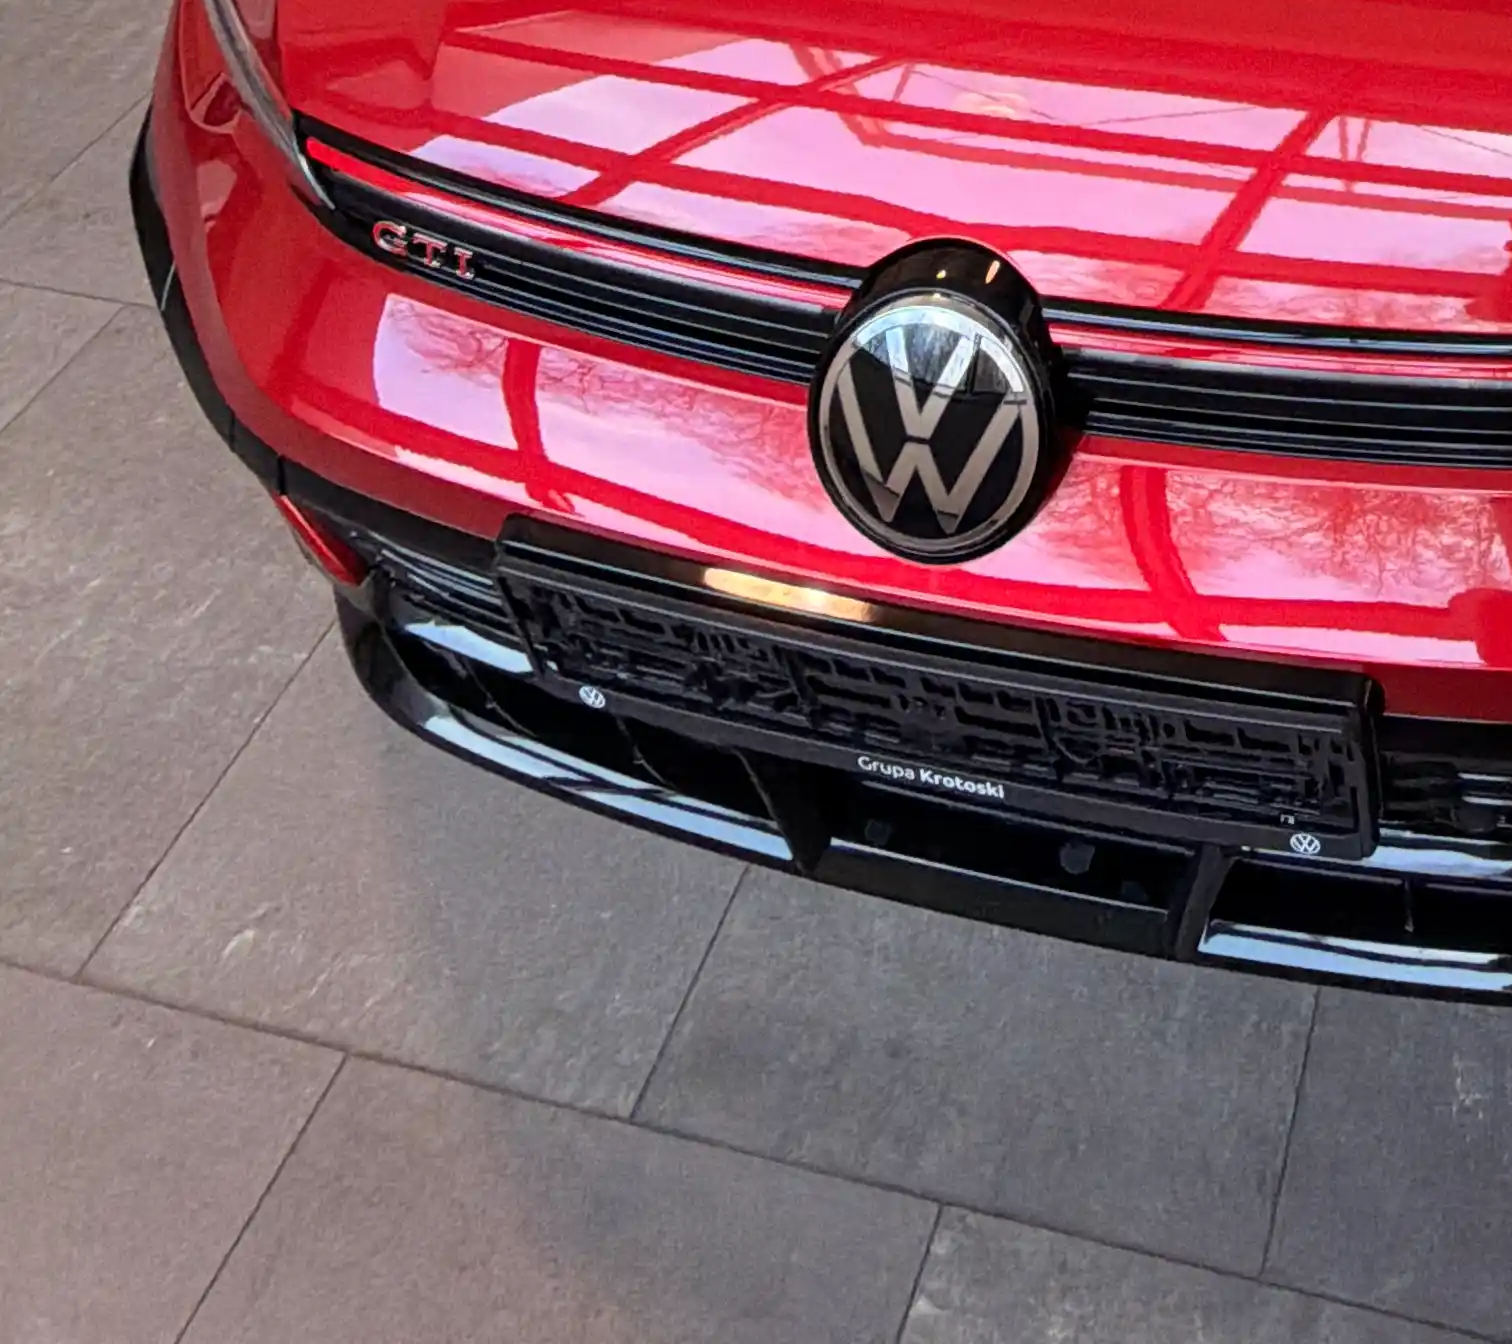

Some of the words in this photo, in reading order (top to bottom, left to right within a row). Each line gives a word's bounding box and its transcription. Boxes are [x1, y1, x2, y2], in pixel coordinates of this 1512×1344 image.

[372, 220, 475, 280] GTI
[825, 310, 1034, 546] VW
[857, 756, 916, 781] Grupa
[919, 768, 1005, 799] Krotoski
